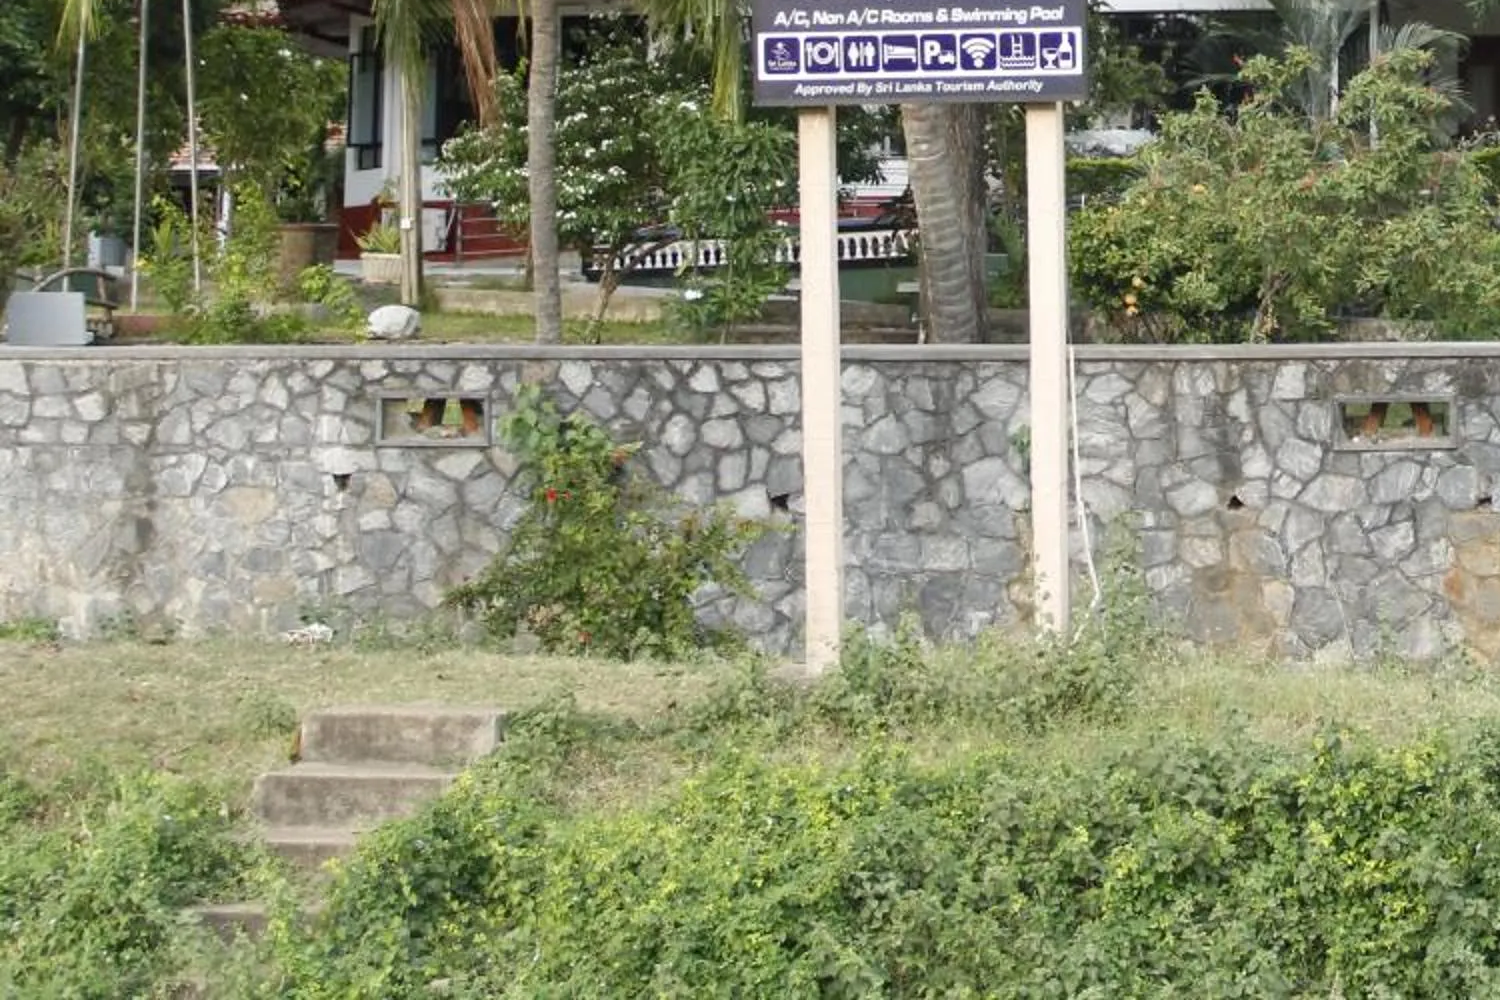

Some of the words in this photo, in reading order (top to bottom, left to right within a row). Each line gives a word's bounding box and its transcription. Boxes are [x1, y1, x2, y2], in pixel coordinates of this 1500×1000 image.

[812, 10, 845, 24] Non
[846, 8, 879, 26] A/C
[881, 8, 934, 23] Rooms
[935, 8, 949, 22] &
[951, 7, 1028, 25] Swimming
[1030, 5, 1065, 21] Pool
[923, 40, 941, 65] P
[794, 83, 855, 97] Approved
[857, 82, 874, 96] By
[875, 81, 893, 94] Sri
[895, 81, 932, 94] Lanka
[935, 81, 985, 92] Tourism
[986, 79, 1044, 93] Authority
